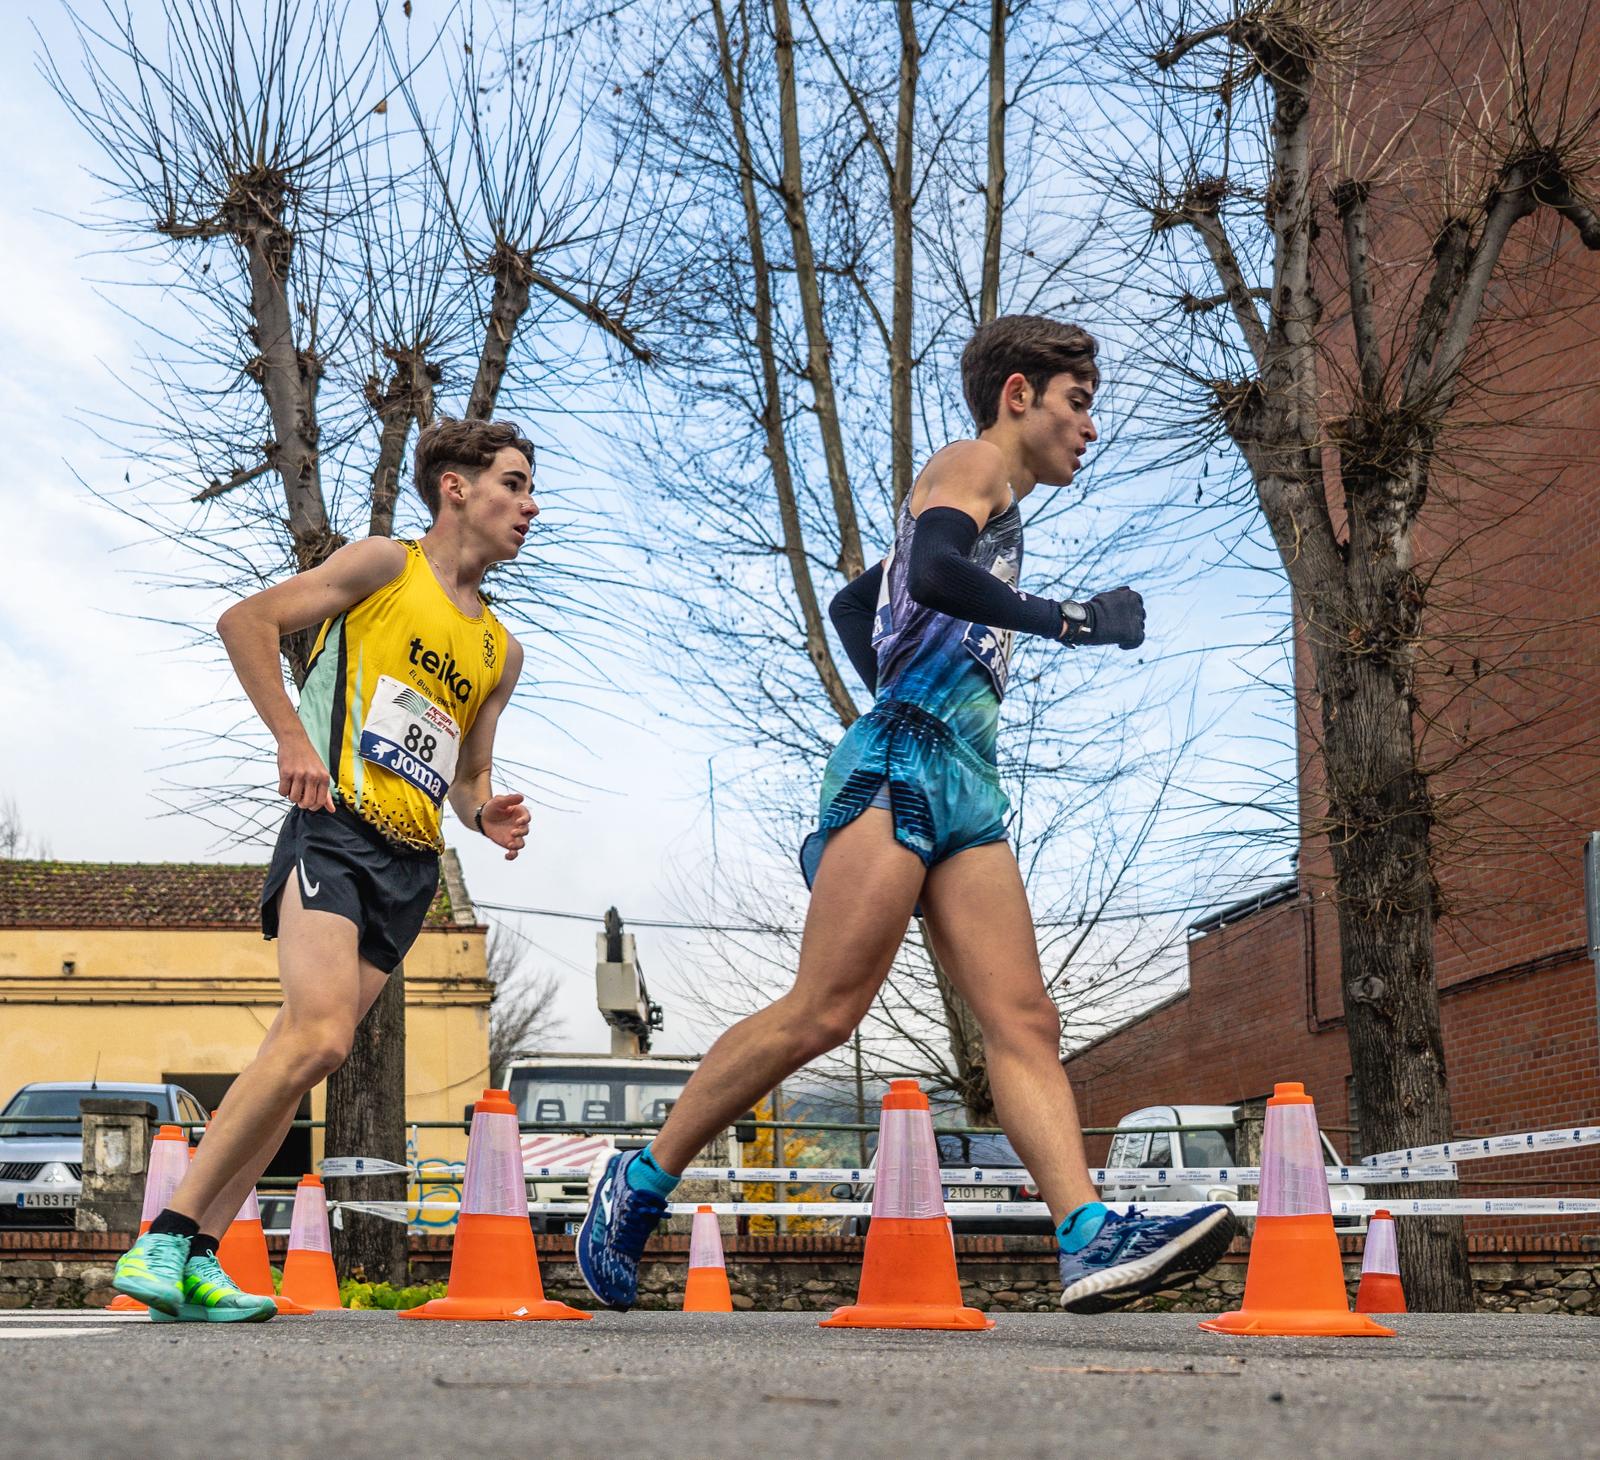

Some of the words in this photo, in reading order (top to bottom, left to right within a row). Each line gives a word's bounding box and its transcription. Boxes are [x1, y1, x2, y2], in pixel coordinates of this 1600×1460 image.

[408, 637, 473, 705] teika
[408, 669, 418, 681] EL
[416, 678, 434, 698] BUEN
[403, 723, 438, 763] 88
[26, 1194, 59, 1206] 4183
[62, 1193, 80, 1206] FF
[950, 1187, 976, 1199] 2101
[983, 1187, 1004, 1199] FGK
